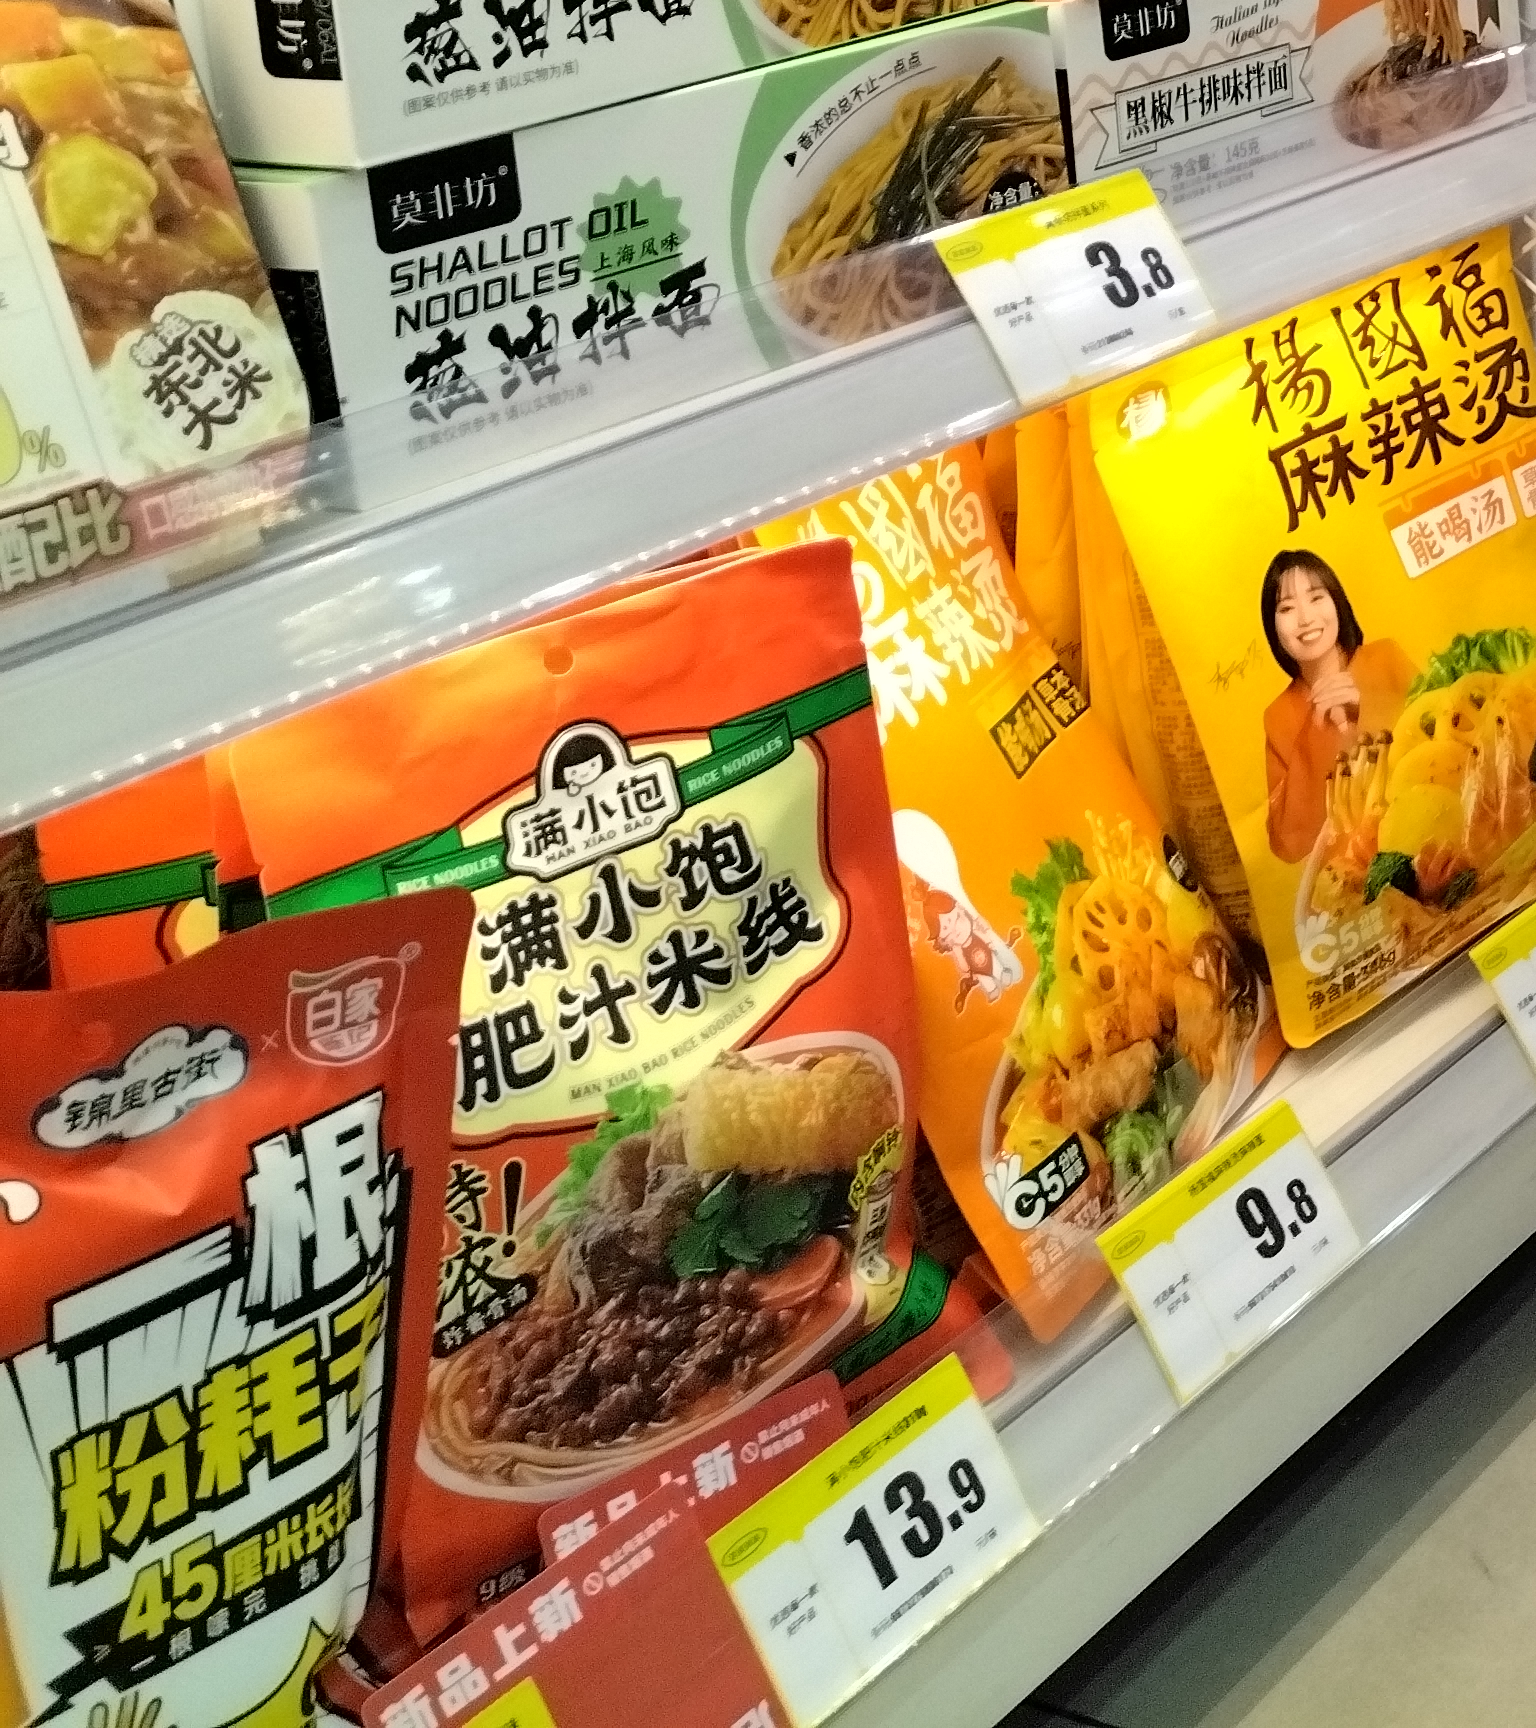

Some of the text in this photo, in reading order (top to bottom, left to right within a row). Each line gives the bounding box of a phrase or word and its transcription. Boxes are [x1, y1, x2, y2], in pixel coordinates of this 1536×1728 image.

[1111, 0, 1177, 45] 莫非坊
[1209, 1, 1259, 35] Italian
[1225, 14, 1280, 48] Noodles
[1125, 53, 1289, 141] 黑椒牛排味拌面
[388, 172, 498, 233] 莫非坊
[388, 198, 650, 297] SHALLOT OIL
[596, 231, 682, 271] 上海风味
[1085, 240, 1176, 310] 3.8
[394, 258, 582, 339] NOODLES
[1240, 241, 1510, 433] 楊國福
[142, 323, 273, 452] 东北大米
[1406, 487, 1505, 570] 能喝汤
[686, 735, 784, 793] RICE NOODLES
[520, 772, 667, 859] 满小饱
[544, 815, 654, 867] MAN XIAO BAO
[432, 854, 500, 885] NOODLES
[477, 819, 763, 995] 满小饱
[305, 977, 384, 1040] 白家
[456, 874, 826, 1114] 肥汁米线
[50, 1090, 392, 1347] 一根
[1235, 1178, 1318, 1259] 9.8
[843, 1457, 987, 1591] 13.9
[379, 1576, 585, 1728] 新品上新
